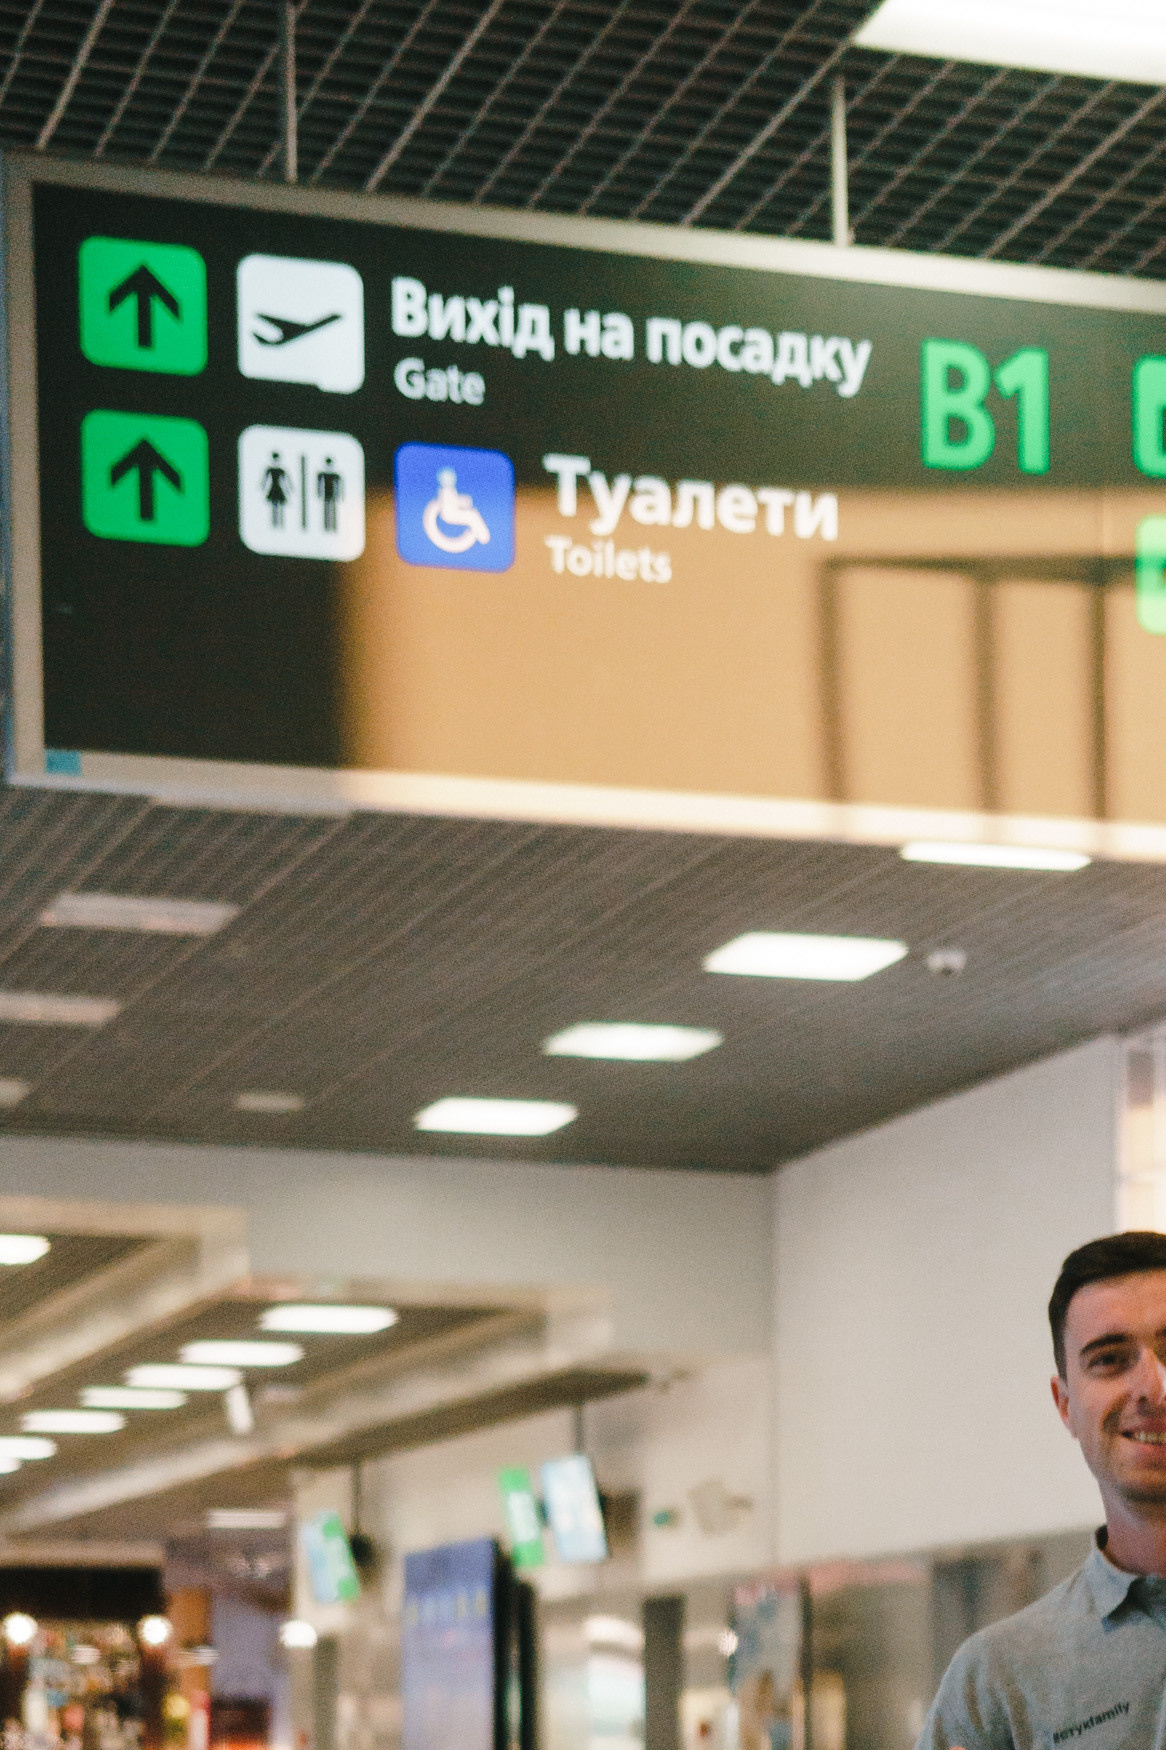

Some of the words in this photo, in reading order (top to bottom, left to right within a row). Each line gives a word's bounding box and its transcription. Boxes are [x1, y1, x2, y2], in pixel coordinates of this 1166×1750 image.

[390, 275, 555, 361] Вихід
[563, 307, 635, 360] на
[644, 316, 873, 399] посадку
[393, 356, 486, 406] Gate
[919, 336, 1050, 477] B1
[542, 453, 840, 542] Туалети
[543, 533, 673, 584] Toilets
